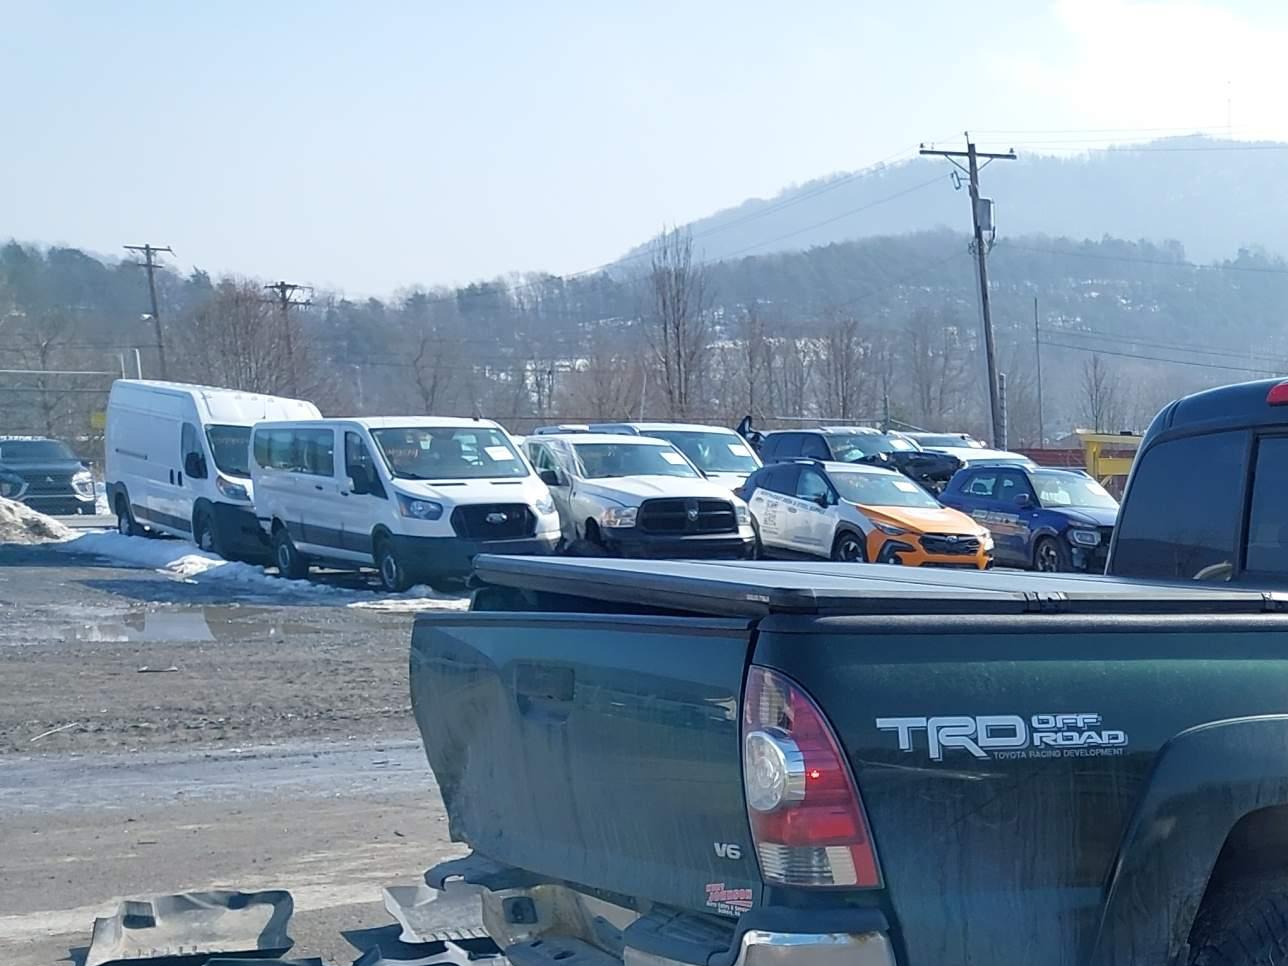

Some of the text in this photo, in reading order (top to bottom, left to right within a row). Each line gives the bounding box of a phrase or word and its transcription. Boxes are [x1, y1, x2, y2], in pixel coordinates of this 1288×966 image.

[1031, 712, 1101, 729] OFF
[876, 714, 1028, 760] TRD
[1033, 730, 1128, 747] ROAD
[993, 748, 1124, 760] TOYOTA RACING DEVELOPMENT
[713, 842, 741, 860] V6
